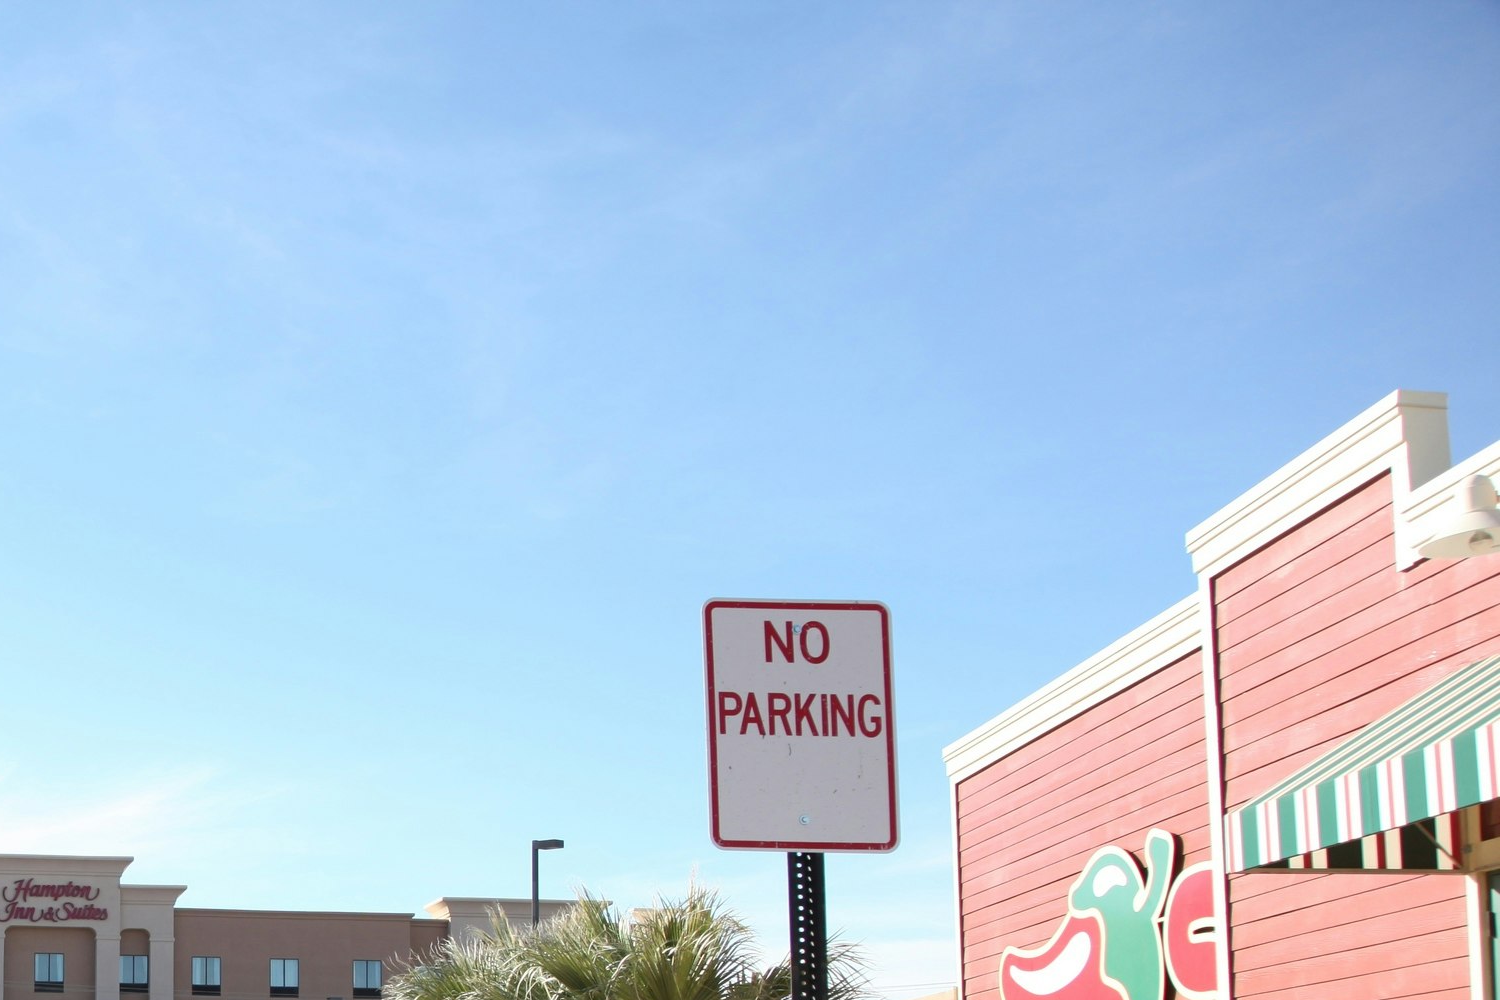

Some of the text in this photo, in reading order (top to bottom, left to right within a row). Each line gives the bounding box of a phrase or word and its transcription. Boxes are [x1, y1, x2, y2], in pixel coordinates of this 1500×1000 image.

[763, 620, 830, 664] NO
[718, 691, 882, 738] PARKING
[3, 878, 100, 902] Hampton
[43, 907, 58, 922] &
[56, 902, 108, 921] Suites
